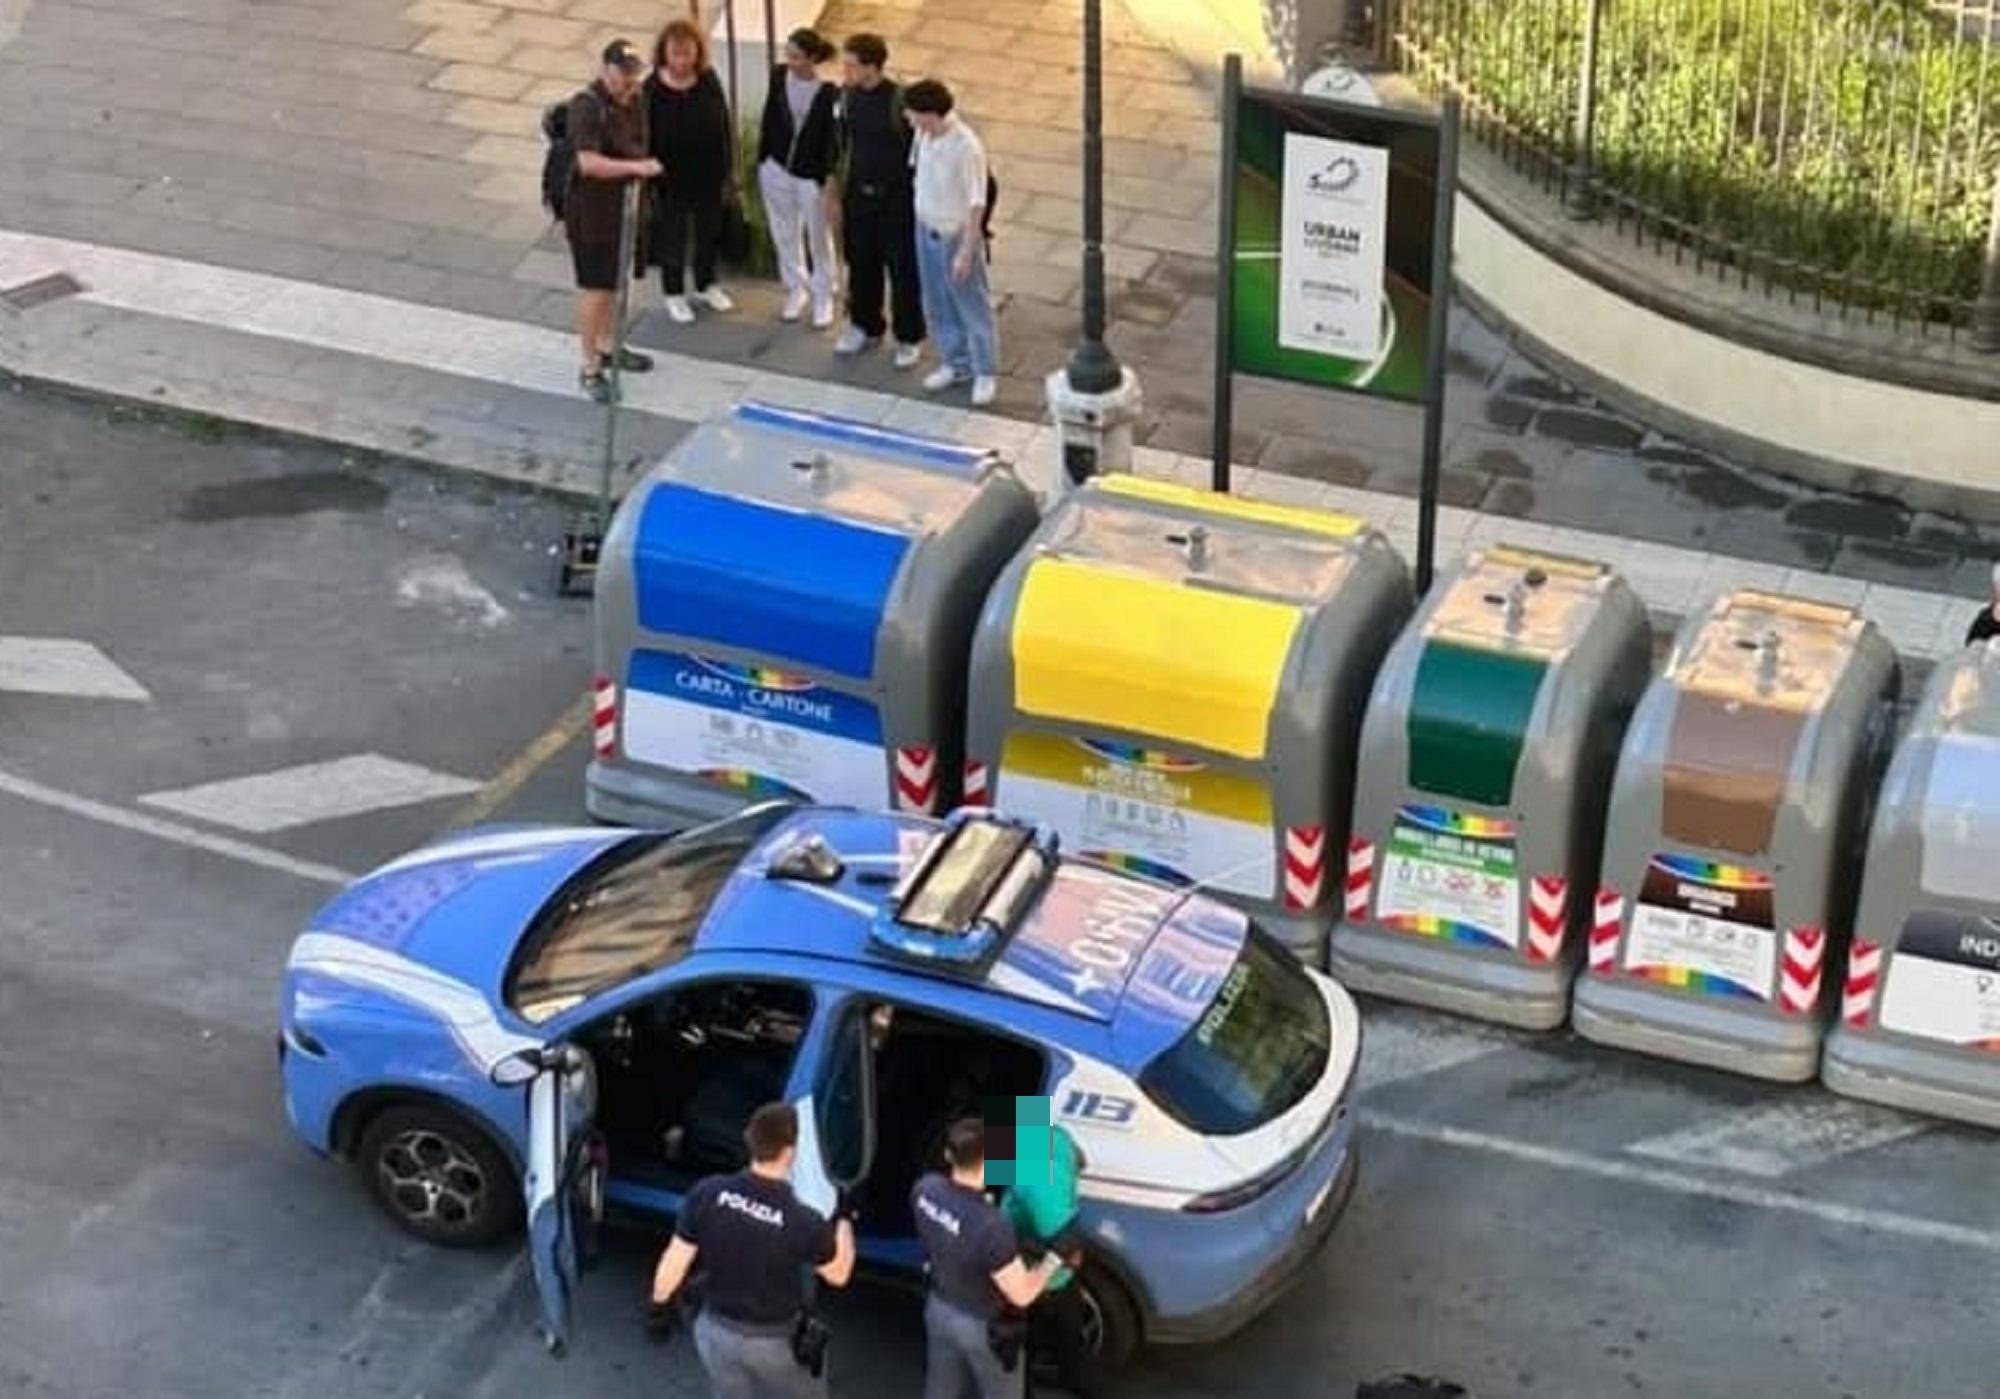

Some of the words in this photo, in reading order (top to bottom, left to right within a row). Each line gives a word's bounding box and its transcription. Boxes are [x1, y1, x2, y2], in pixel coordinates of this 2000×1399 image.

[1304, 221, 1360, 241] URBAN
[675, 670, 733, 698] CARTA
[747, 688, 832, 722] CARTONE
[1062, 1091, 1136, 1122] 113
[719, 1191, 784, 1226] POLIZIA
